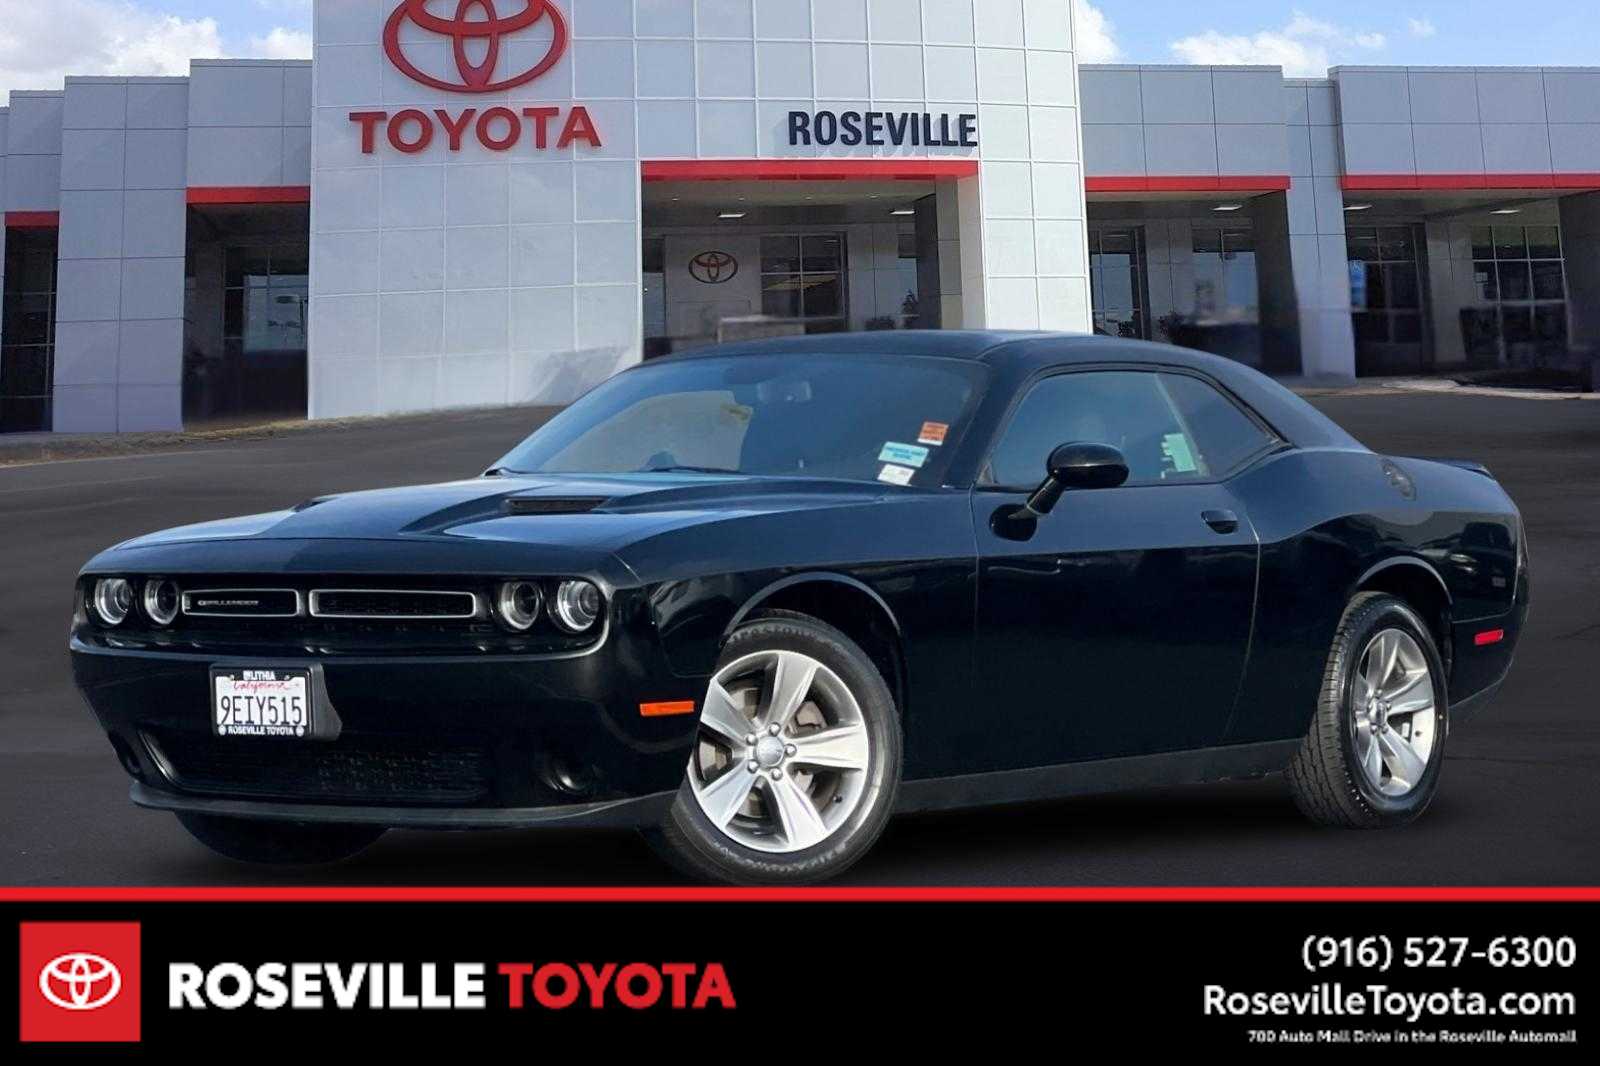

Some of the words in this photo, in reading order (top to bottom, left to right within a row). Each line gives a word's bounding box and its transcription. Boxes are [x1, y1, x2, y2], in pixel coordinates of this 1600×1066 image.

[349, 106, 602, 154] TOYOTA
[789, 111, 978, 147] ROSEVILLE
[250, 670, 276, 681] LITHIA
[233, 680, 290, 694] California
[220, 695, 302, 726] 9EIY515
[227, 725, 265, 736] ROSEVILLE
[266, 726, 294, 736] TOYOTA
